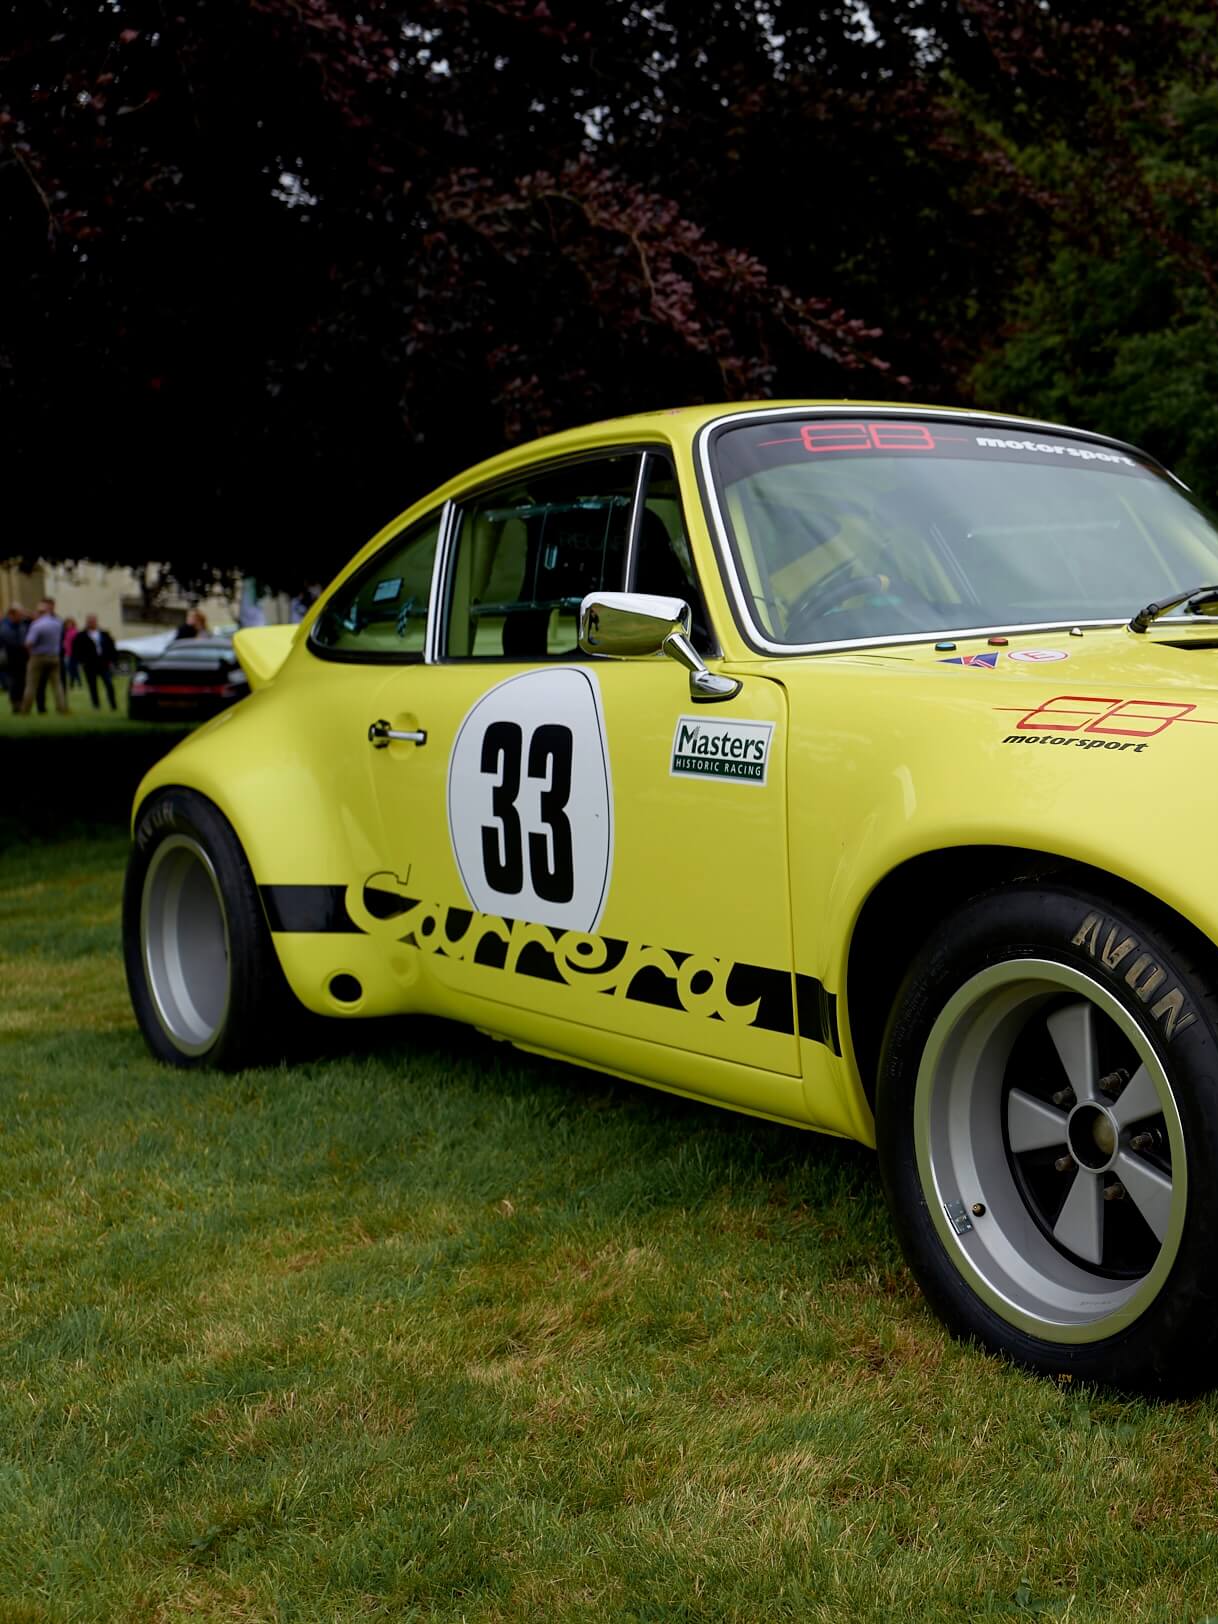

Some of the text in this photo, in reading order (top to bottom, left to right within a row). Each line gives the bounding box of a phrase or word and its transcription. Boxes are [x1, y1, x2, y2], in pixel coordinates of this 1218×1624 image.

[975, 436, 1137, 467] motorsport
[678, 724, 766, 760] Masters
[1002, 733, 1149, 753] motorsport
[676, 758, 761, 777] HISTORIC RACING
[480, 720, 575, 904] 33
[344, 863, 763, 1026] Carrera
[1070, 911, 1199, 1042] AVON
